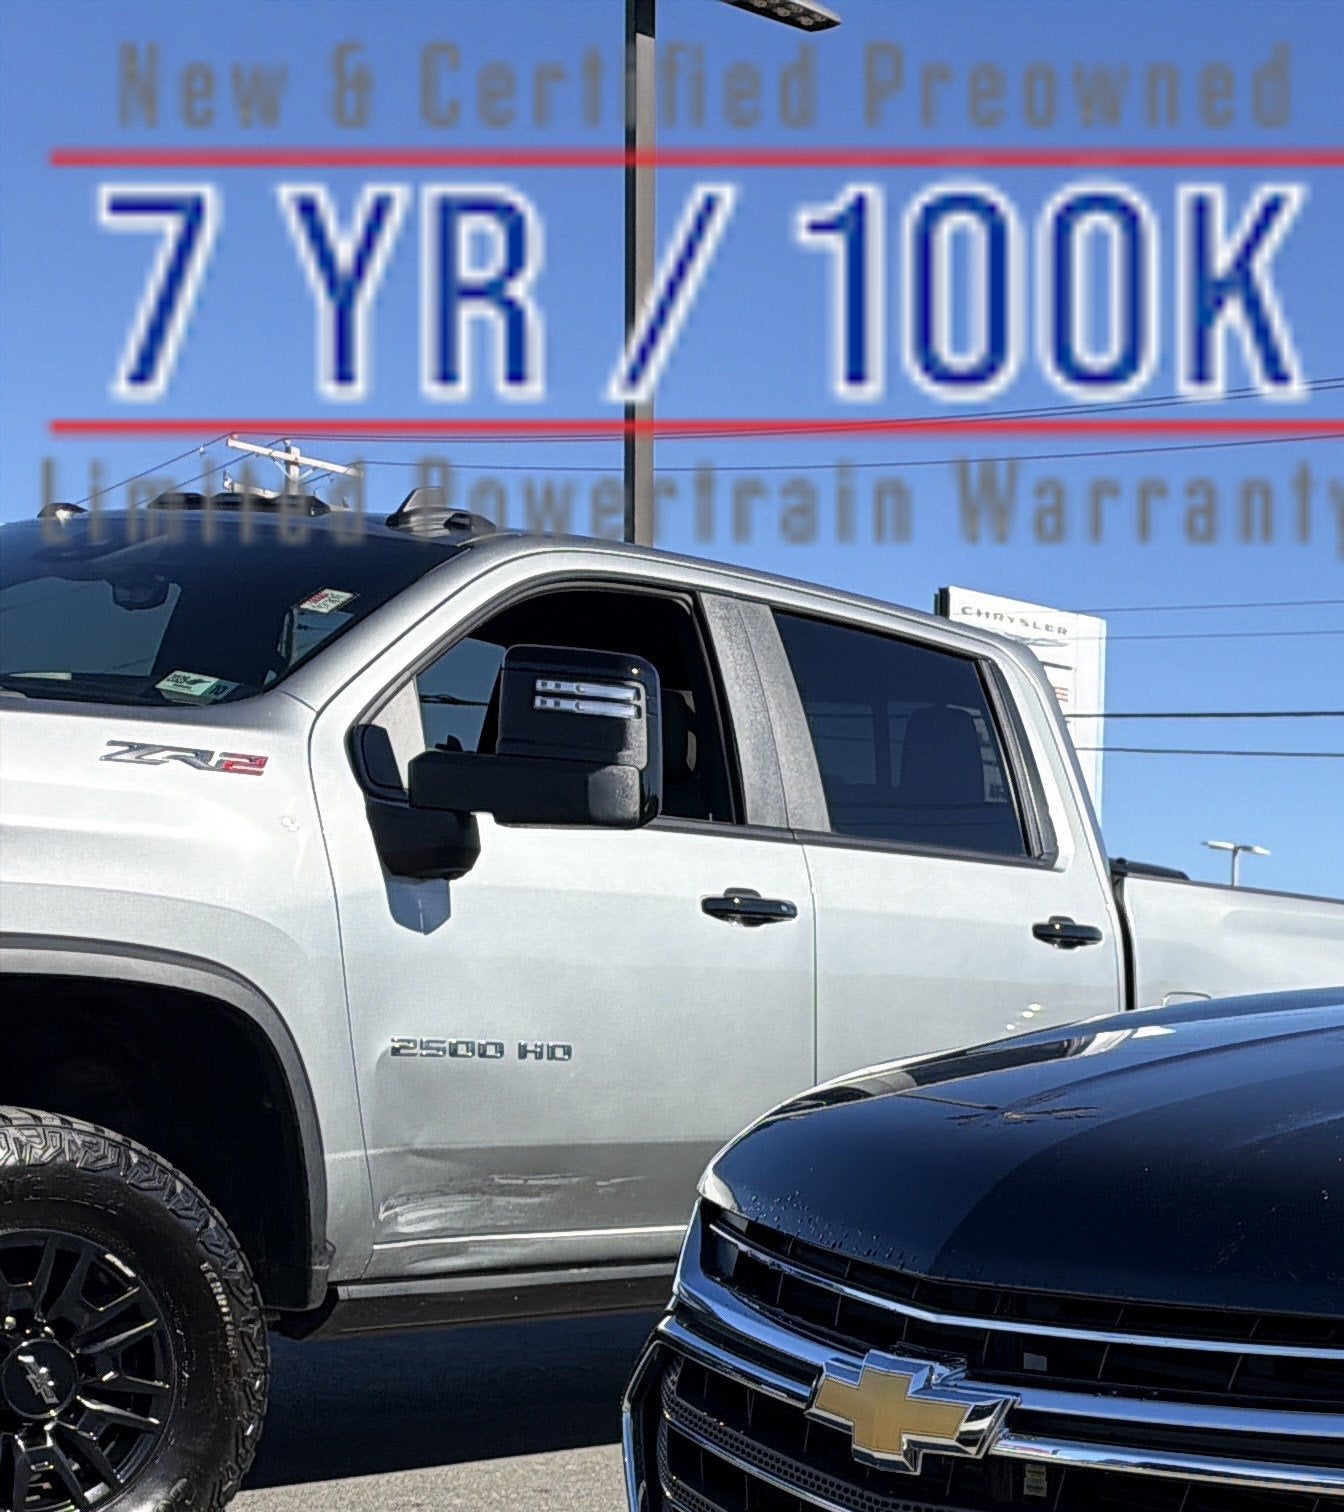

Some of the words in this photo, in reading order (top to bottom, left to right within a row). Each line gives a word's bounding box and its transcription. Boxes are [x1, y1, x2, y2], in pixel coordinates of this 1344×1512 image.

[960, 605, 1068, 636] CHRYSLER
[99, 739, 269, 777] ZR2
[390, 1036, 505, 1059] 2500
[517, 1040, 573, 1062] HD
